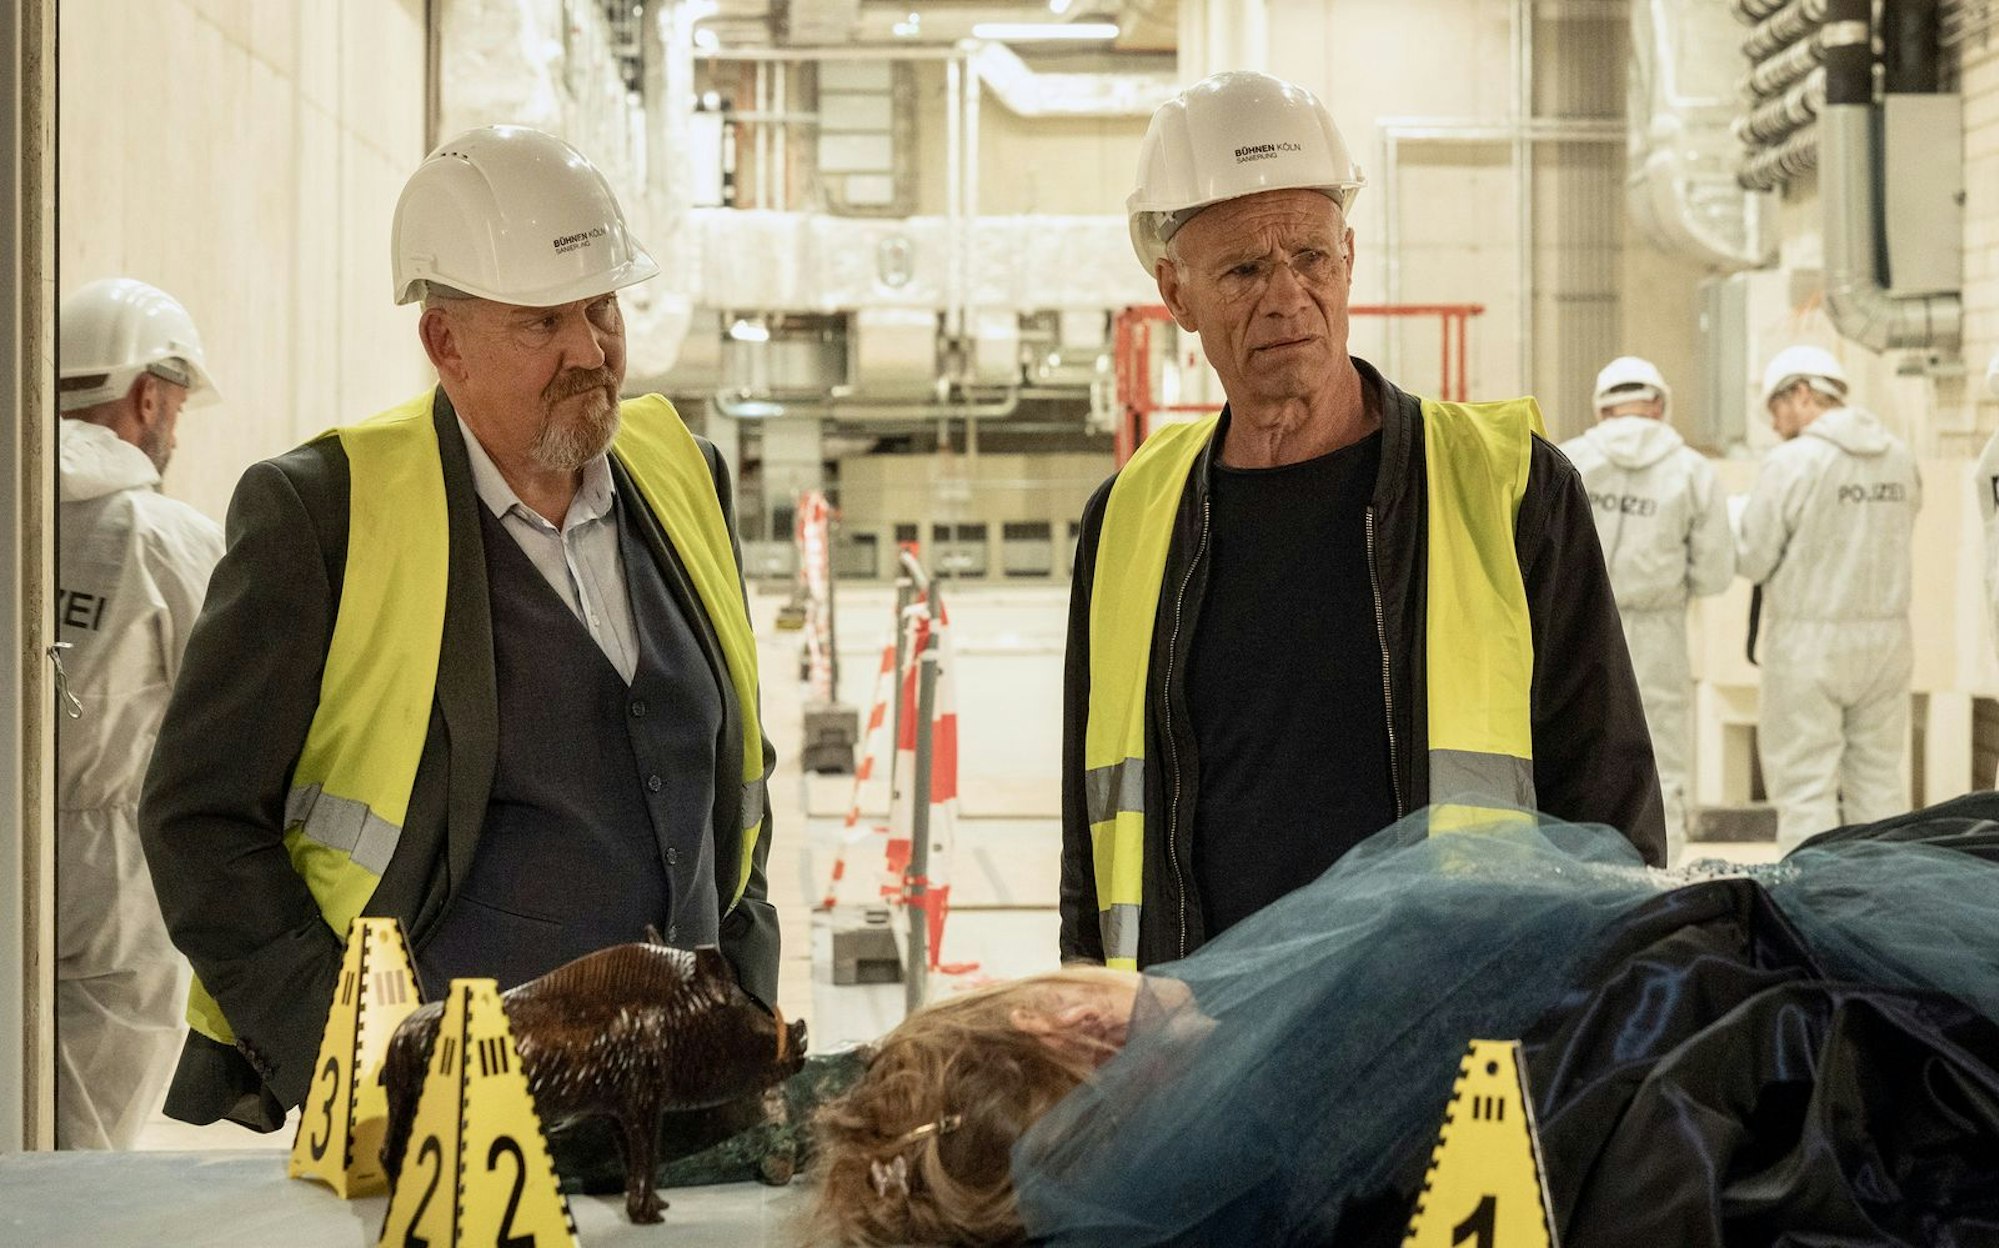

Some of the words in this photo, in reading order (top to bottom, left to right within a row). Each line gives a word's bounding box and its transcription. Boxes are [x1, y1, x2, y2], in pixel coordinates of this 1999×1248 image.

[1234, 144, 1275, 157] BÜHNEN
[1276, 142, 1302, 152] KÖLN
[1236, 152, 1278, 164] SANIERUNG
[553, 232, 588, 248] BÜHNEN
[1588, 492, 1658, 517] POIZEI
[60, 589, 106, 631] EI
[310, 1056, 340, 1162] 3
[403, 1134, 443, 1248] 2
[486, 1135, 536, 1248] 2
